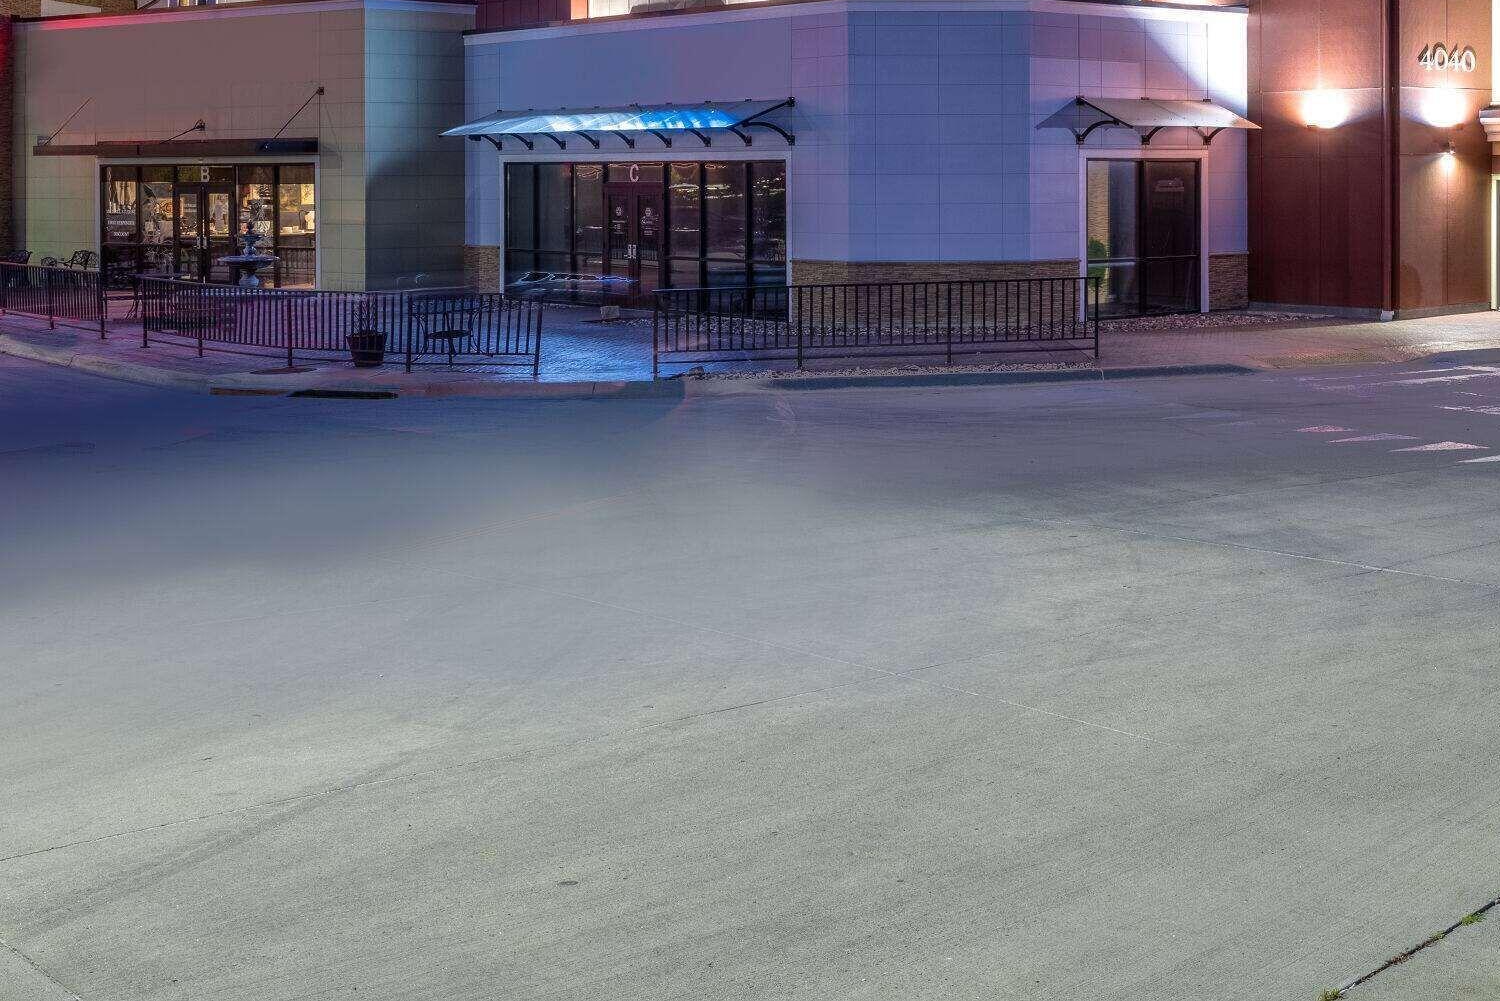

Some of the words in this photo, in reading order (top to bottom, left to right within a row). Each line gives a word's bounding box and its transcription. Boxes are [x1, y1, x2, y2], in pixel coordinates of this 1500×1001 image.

[1418, 45, 1477, 73] 4040
[200, 165, 210, 182] B
[629, 163, 640, 183] C
